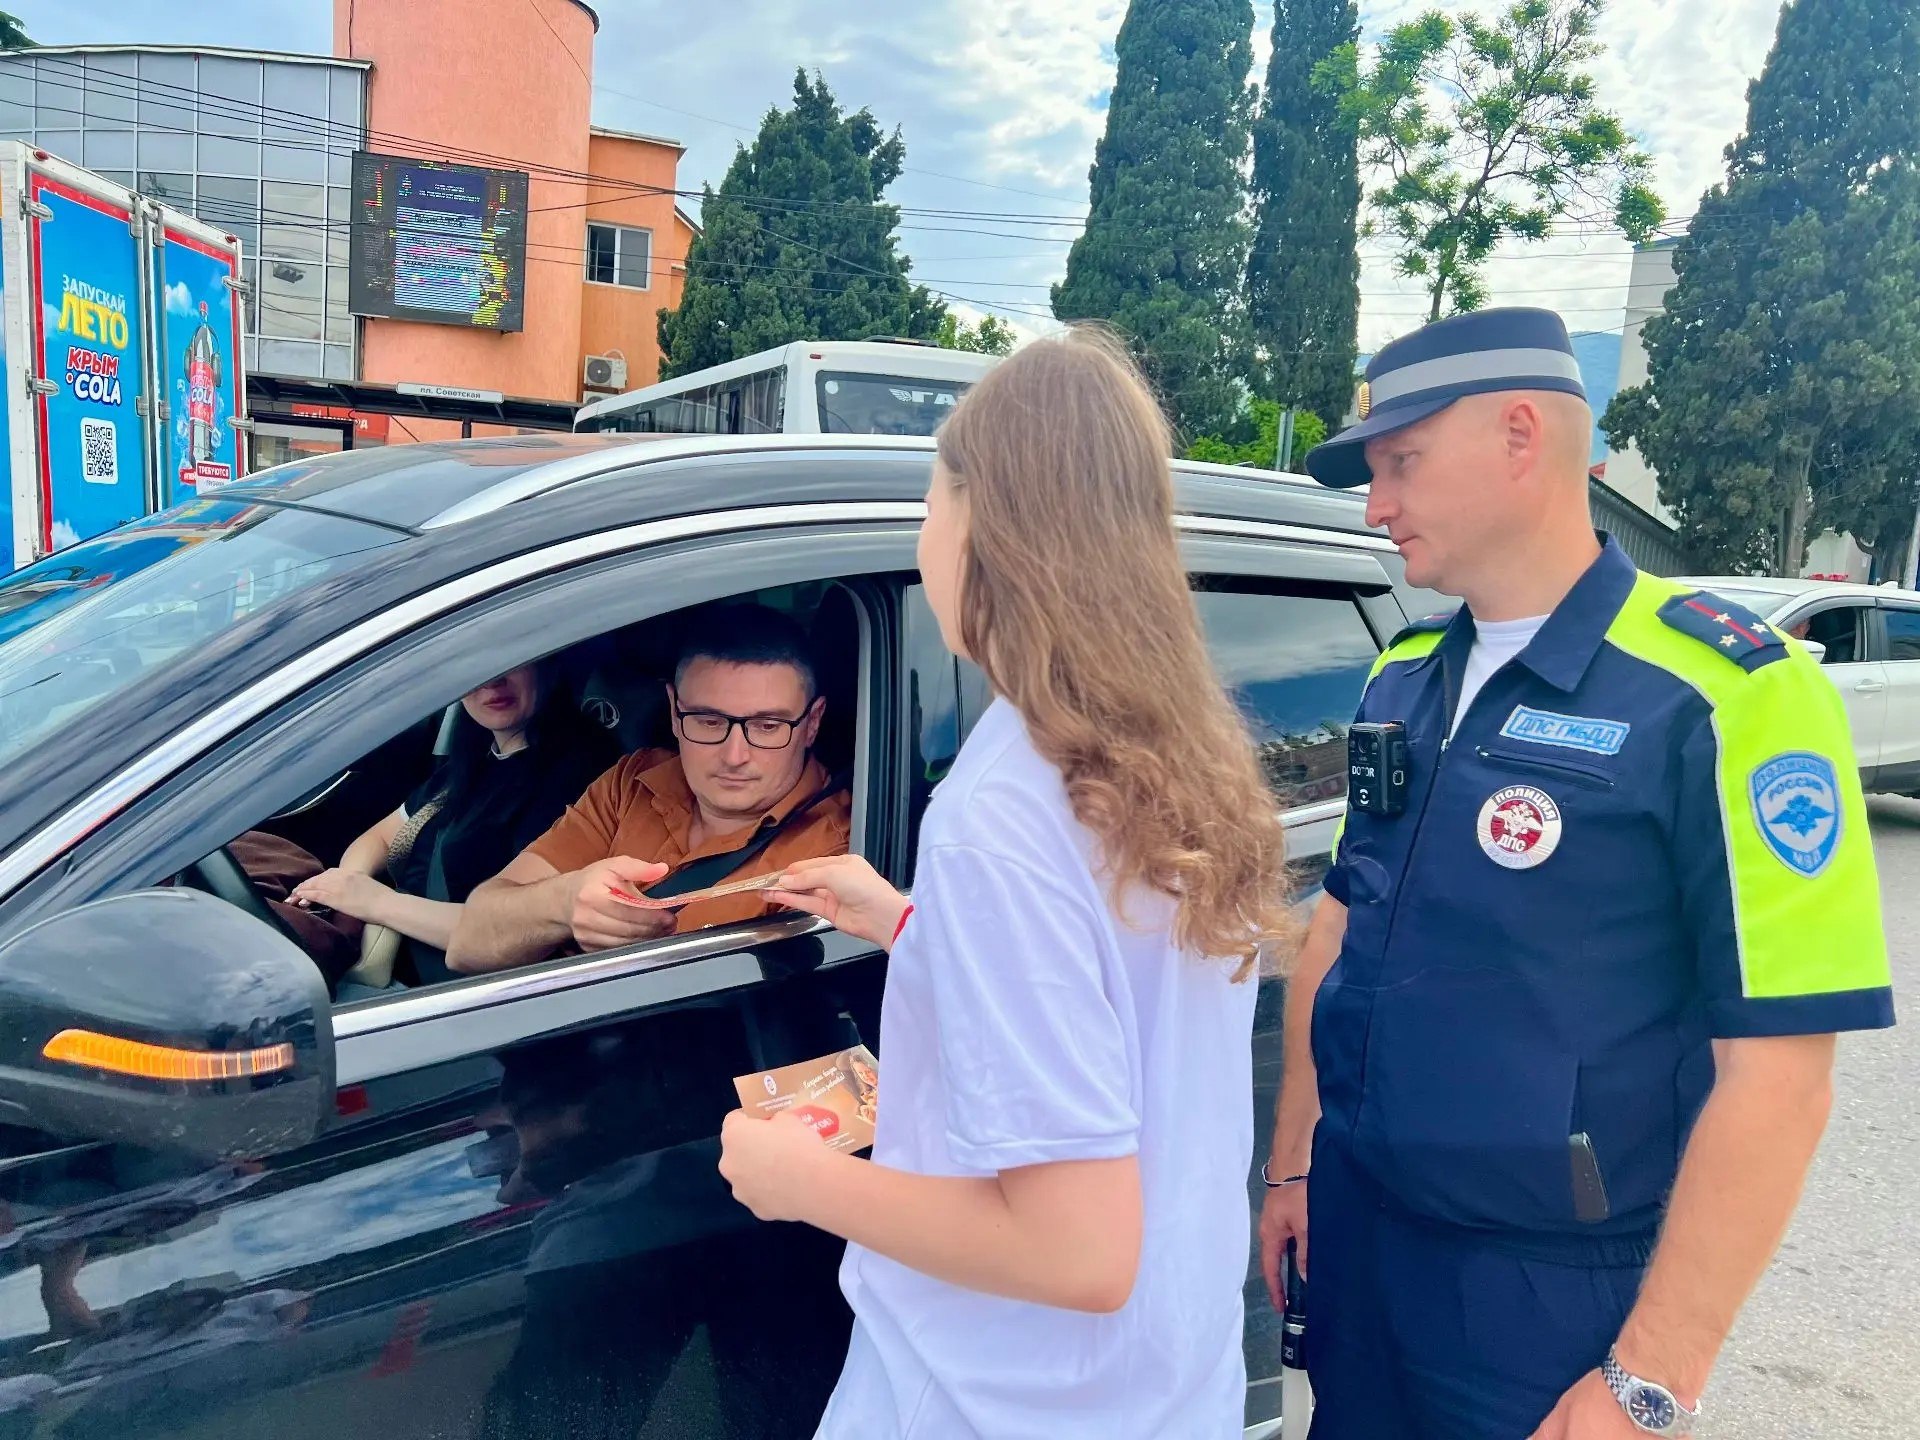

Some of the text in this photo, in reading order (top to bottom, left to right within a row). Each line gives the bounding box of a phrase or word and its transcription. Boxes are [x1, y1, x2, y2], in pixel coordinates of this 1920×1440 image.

[62, 274, 126, 314] ЗАПУСКАЙ
[58, 291, 129, 350] ЛЕТО
[67, 346, 119, 378] КРЫМ
[74, 373, 122, 405] COLA
[191, 388, 213, 406] COLA
[436, 387, 481, 399] Советская
[912, 391, 967, 406] ГА
[198, 466, 229, 477] ТРЕБУЮТСЯ
[1494, 787, 1557, 820] ПОЛИЦИЯ
[1496, 833, 1526, 852] ДПС
